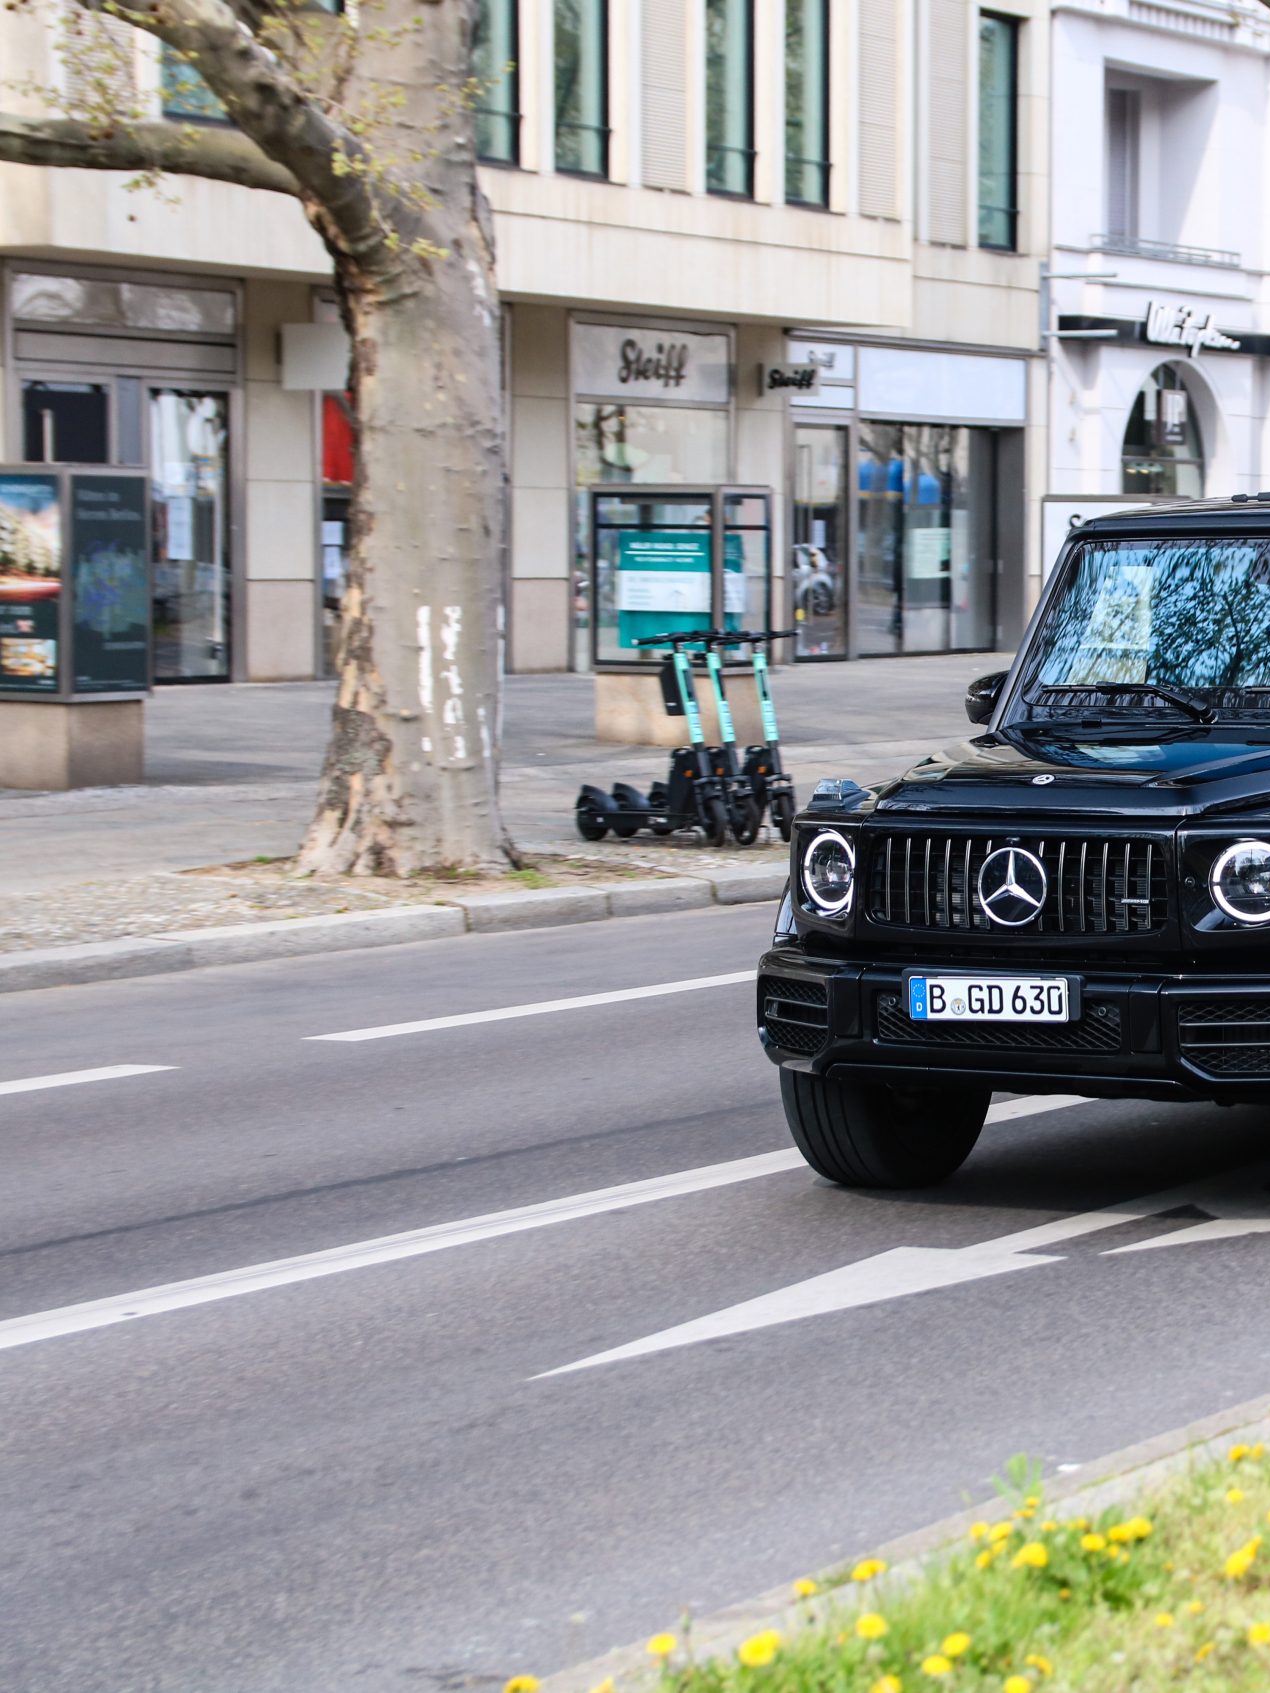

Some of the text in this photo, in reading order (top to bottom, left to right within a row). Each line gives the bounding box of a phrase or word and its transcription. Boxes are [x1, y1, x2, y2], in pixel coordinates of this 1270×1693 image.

[618, 337, 687, 388] Steiff
[767, 368, 816, 390] Steiff
[916, 1002, 923, 1012] D
[929, 984, 1064, 1016] B GD 630
